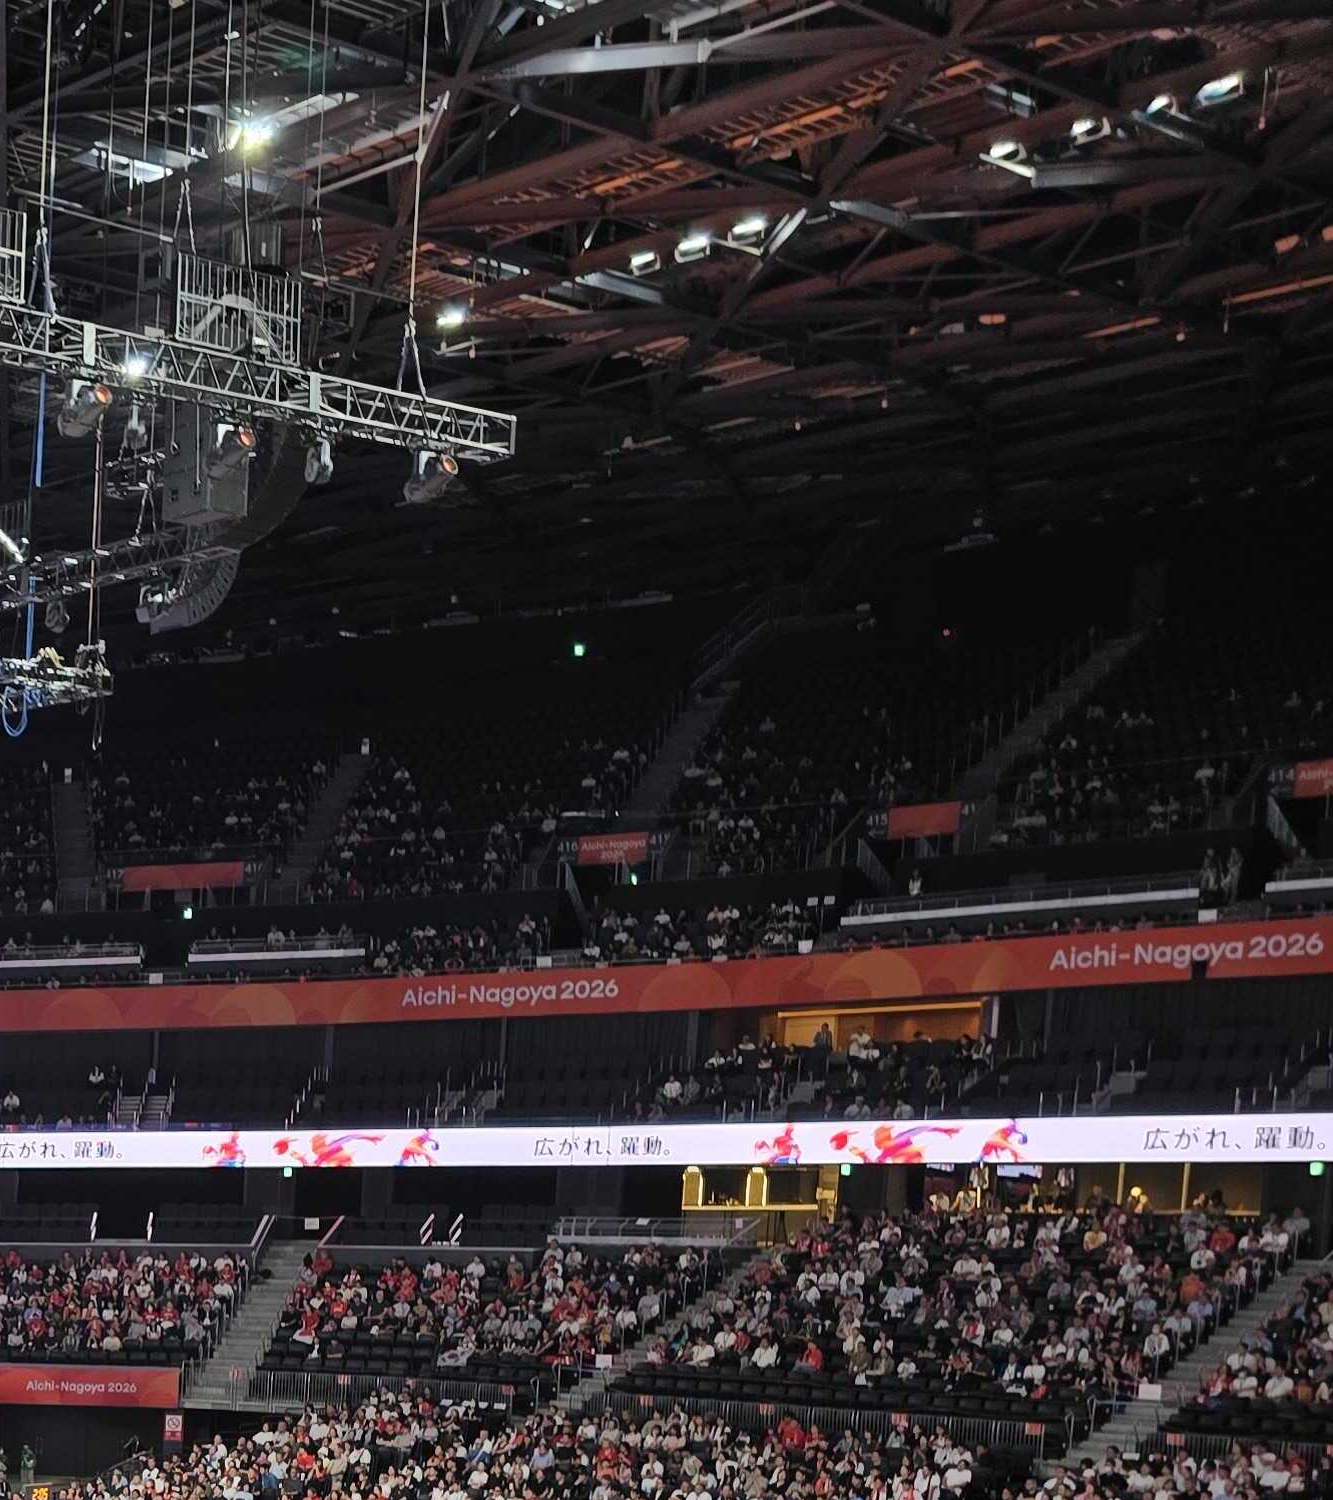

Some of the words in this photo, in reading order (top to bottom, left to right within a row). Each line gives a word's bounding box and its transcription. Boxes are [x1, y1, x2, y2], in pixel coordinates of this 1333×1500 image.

[1049, 942, 1244, 971] Aichi-Nagoya
[1248, 932, 1324, 960] 2026
[402, 983, 557, 1008] Aichi-Nagoya
[560, 978, 620, 1001] 2026
[534, 1136, 673, 1157] 広がれ、躍動。
[1145, 1125, 1330, 1152] 広がれ、躍動。
[26, 1379, 105, 1394] Aichi-Nagoya
[107, 1380, 137, 1393] 2026
